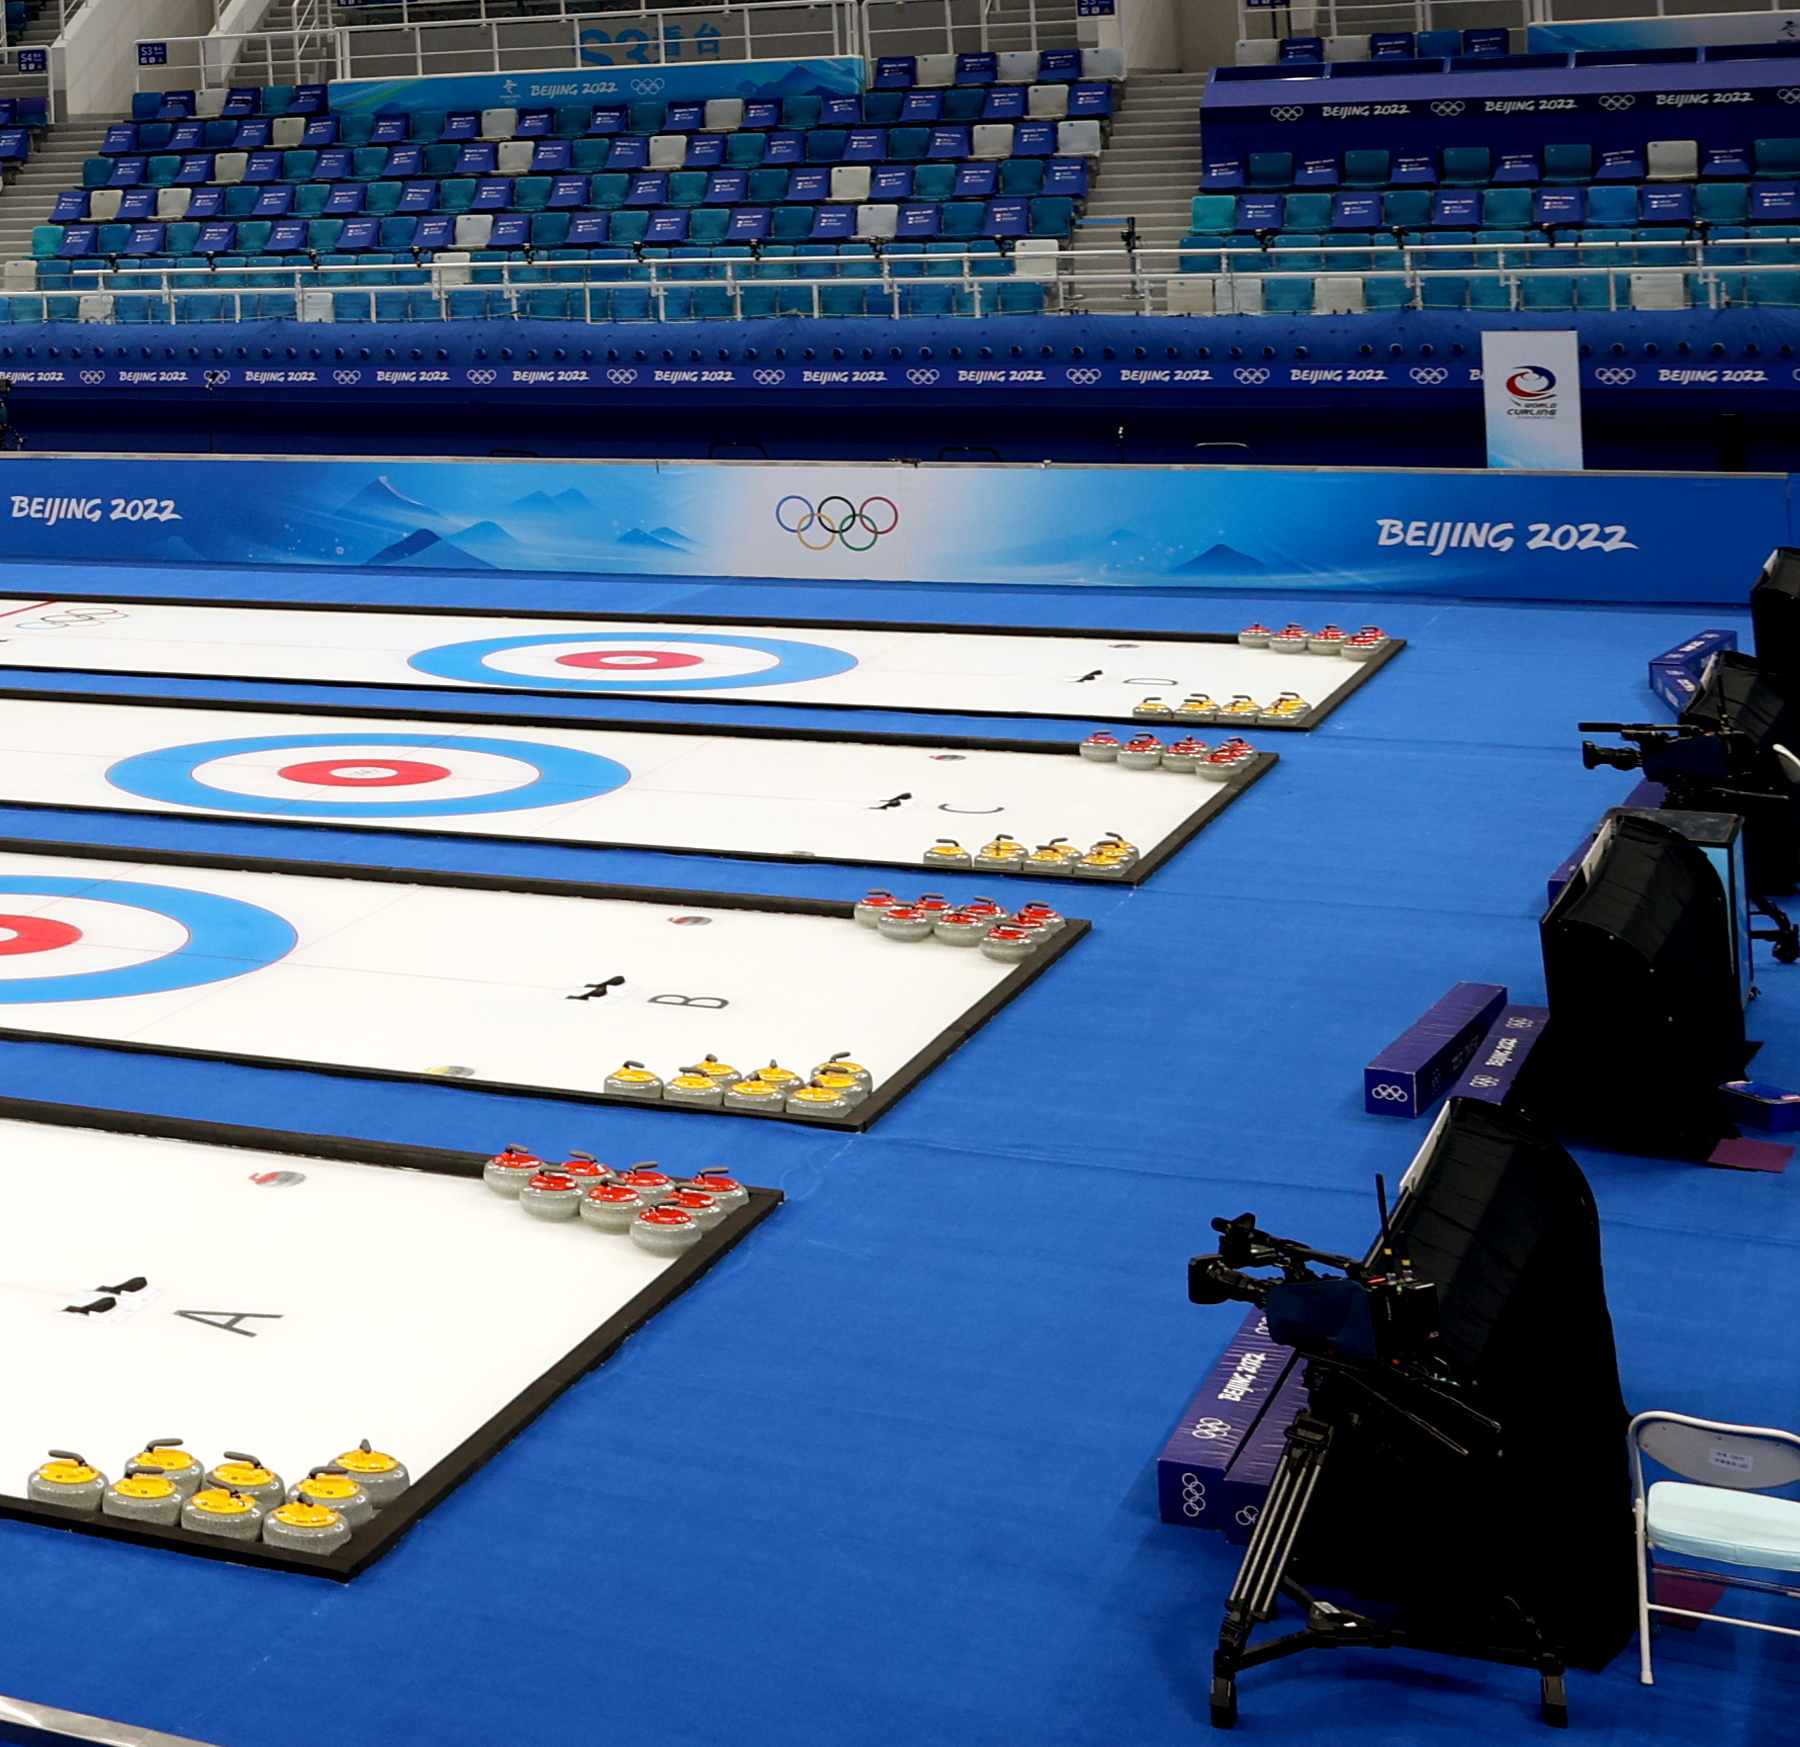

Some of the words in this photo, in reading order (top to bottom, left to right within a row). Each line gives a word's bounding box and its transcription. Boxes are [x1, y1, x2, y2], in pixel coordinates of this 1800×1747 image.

[20, 53, 32, 62] S4
[141, 47, 152, 56] S3
[531, 84, 578, 98] BEIJING
[582, 82, 618, 94] 2022
[1485, 101, 1534, 114] BEIJING
[1539, 99, 1577, 109] 2022
[1656, 94, 1708, 107] BEIJING
[1713, 92, 1753, 103] 2022
[1322, 106, 1369, 119] BEIJING
[1374, 104, 1410, 115] 2022
[37, 372, 65, 381] 2022
[119, 371, 156, 383] BEIJING
[159, 372, 188, 381] 2022
[246, 371, 284, 384] BEIJING
[287, 372, 317, 381] 2022
[377, 371, 416, 384] BEIJING
[419, 371, 450, 381] 2022
[513, 371, 554, 384] BEIJING
[557, 371, 589, 381] 2022
[654, 371, 698, 384] BEIJING
[701, 371, 734, 381] 2022
[803, 371, 848, 384] BEIJING
[852, 371, 887, 381] 2022
[958, 371, 1005, 384] BEIJING
[1009, 370, 1046, 381] 2022
[1121, 370, 1170, 384] BEIJING
[1174, 370, 1213, 380] 2022
[1291, 369, 1342, 384] BEIJING
[1347, 369, 1388, 380] 2022
[1659, 369, 1718, 384] BEIJING
[1722, 370, 1767, 381] 2022
[11, 496, 101, 525] BEIJING
[110, 499, 182, 521] 2022
[1376, 519, 1514, 555] BEIJING
[1526, 523, 1638, 552] 2022
[647, 994, 730, 1009] B
[173, 1310, 284, 1338] A
[1236, 1352, 1267, 1374] 2022
[1218, 1372, 1257, 1401] BEIJING
